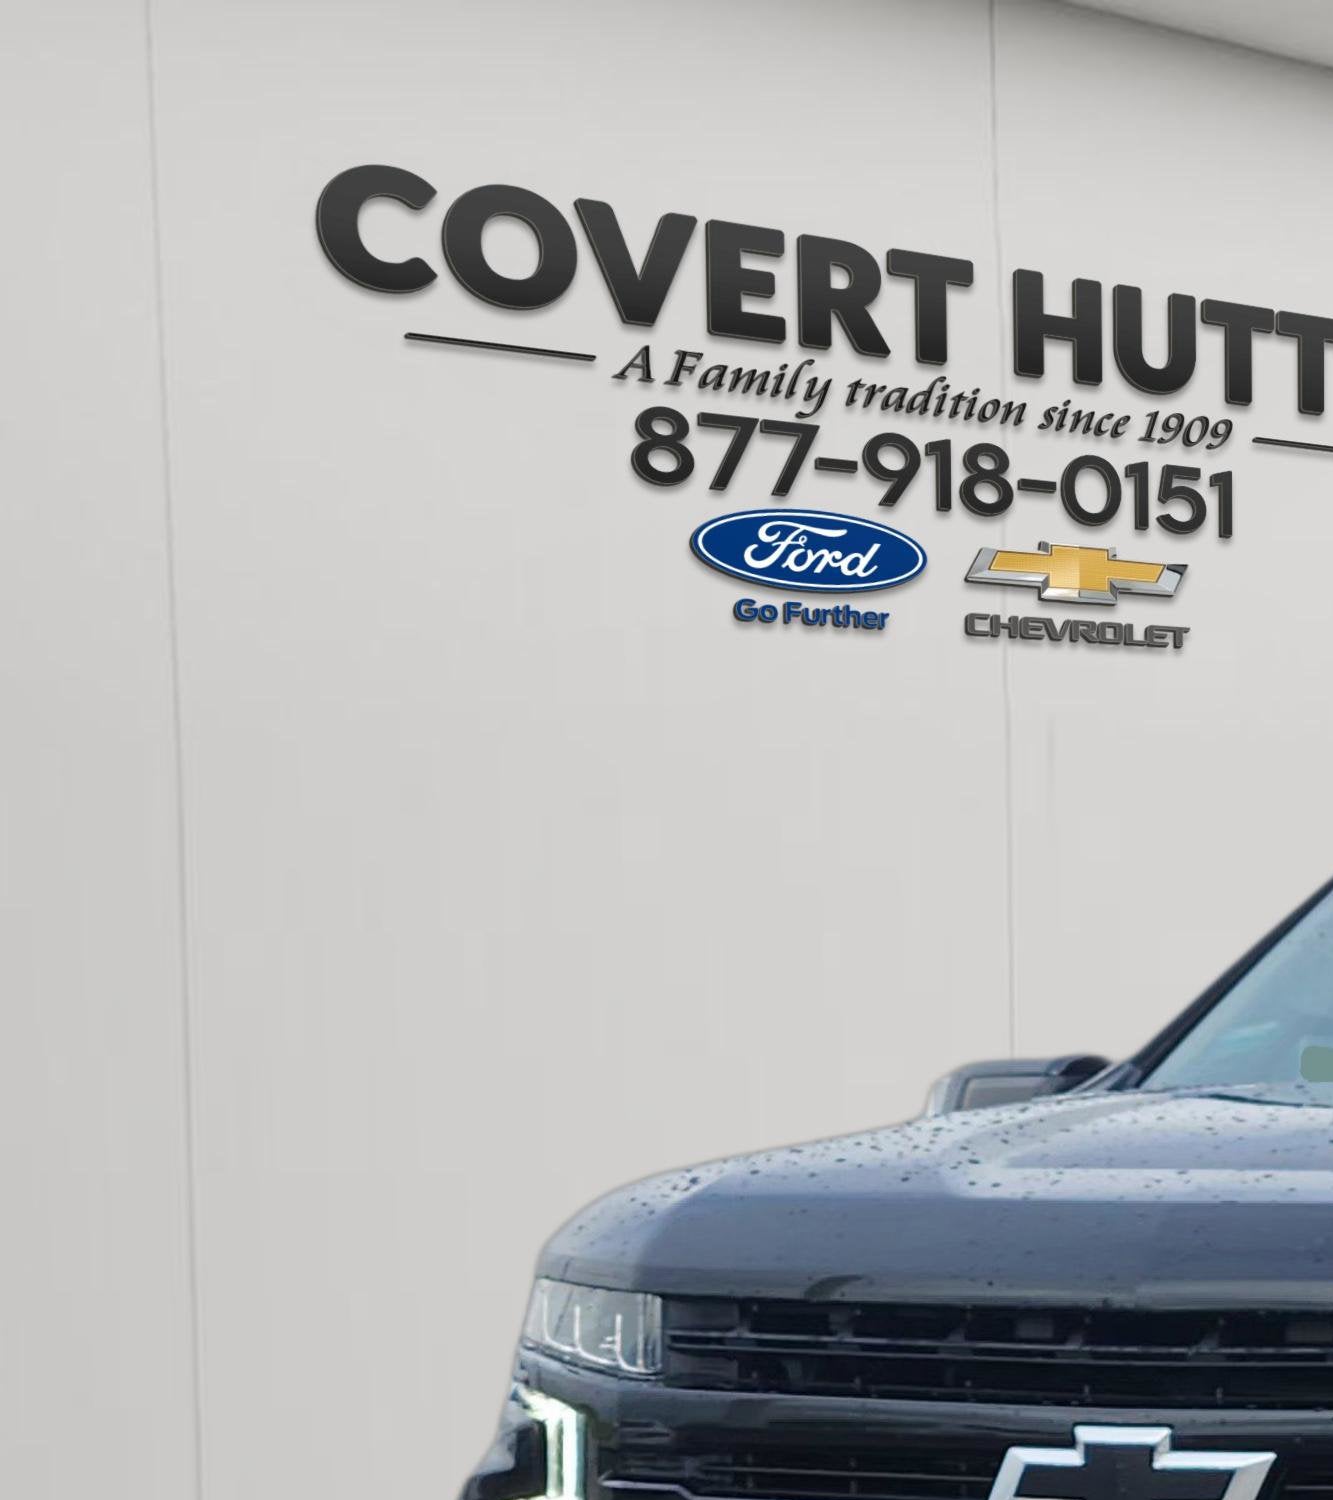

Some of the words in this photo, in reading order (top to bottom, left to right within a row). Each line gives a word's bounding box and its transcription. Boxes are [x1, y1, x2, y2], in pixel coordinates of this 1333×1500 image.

[315, 163, 974, 366] COVERT
[612, 345, 655, 386] A
[664, 349, 833, 420] Family
[846, 376, 1025, 428] tradition
[1038, 399, 1131, 441] since
[1138, 409, 1235, 451] 1909
[629, 404, 1235, 540] 877-918-0151
[743, 519, 882, 578] Ford
[733, 598, 779, 625] Go
[784, 602, 891, 630] Further
[964, 612, 1191, 649] CHEVROLET
